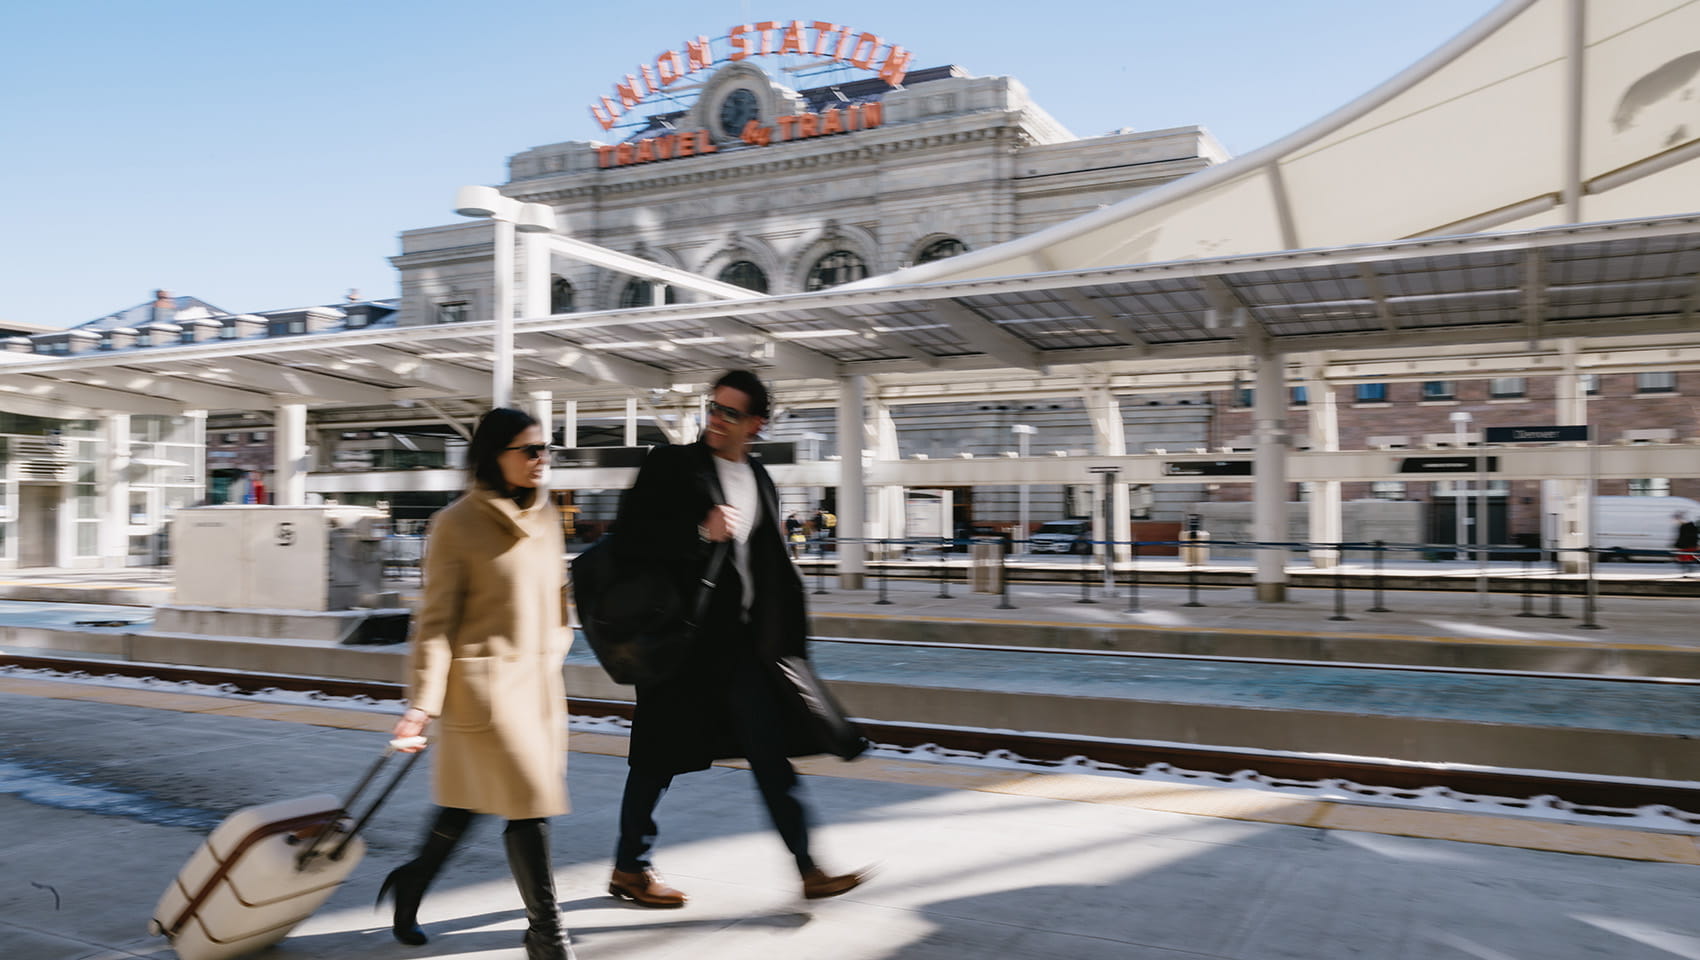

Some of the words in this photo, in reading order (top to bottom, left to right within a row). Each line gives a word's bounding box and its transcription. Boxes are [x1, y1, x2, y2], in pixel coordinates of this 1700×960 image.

[590, 35, 713, 130] UNION
[730, 20, 912, 85] STATION
[597, 129, 718, 168] TRAVEL
[741, 120, 771, 146] &
[777, 102, 882, 141] TRAIN
